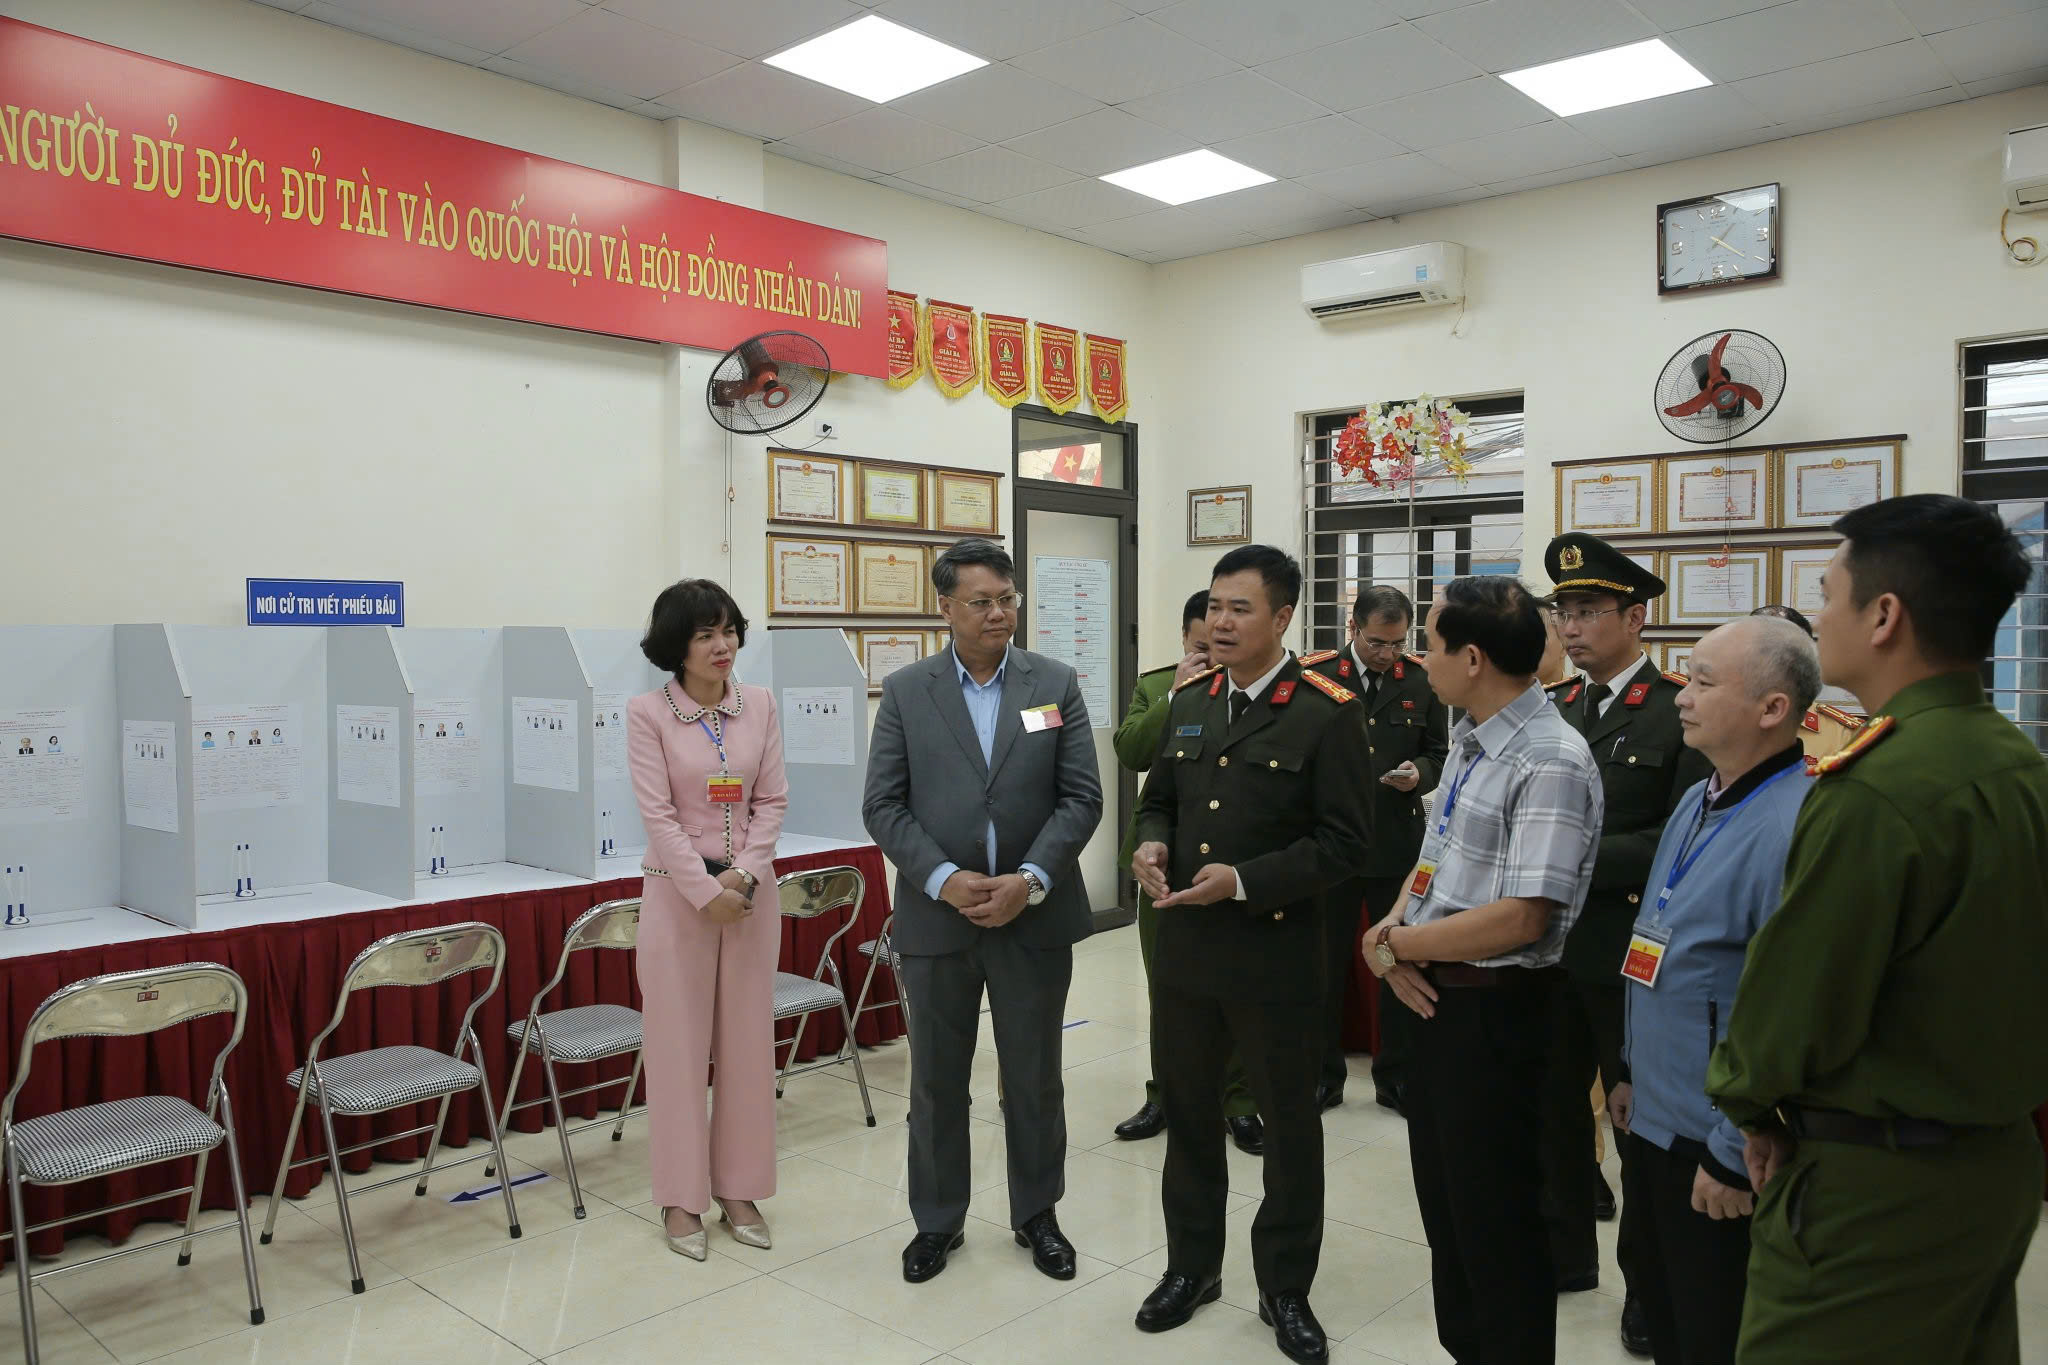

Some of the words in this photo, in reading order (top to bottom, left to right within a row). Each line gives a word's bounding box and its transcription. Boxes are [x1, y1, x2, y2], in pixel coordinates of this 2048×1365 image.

[0, 101, 121, 185] NGƯỜI
[132, 113, 185, 198] ĐỦ
[196, 136, 272, 224] ĐỨC,
[281, 147, 327, 226] ĐỦ
[336, 167, 389, 238] TÀI
[397, 181, 459, 251] VÀO
[466, 193, 541, 268] QUỐC
[547, 212, 593, 288] HỘI
[600, 224, 634, 284] VÀ
[640, 232, 681, 304] HỘI
[687, 233, 749, 307] ĐỒNG
[754, 260, 812, 319] NHÂN
[817, 271, 861, 329] DÂN!
[256, 595, 276, 614] NƠI
[279, 592, 295, 615] CỬ
[297, 597, 315, 614] TRI
[317, 592, 340, 615] VIẾT
[342, 593, 373, 615] PHIẾU
[375, 593, 396, 615] BẦU
